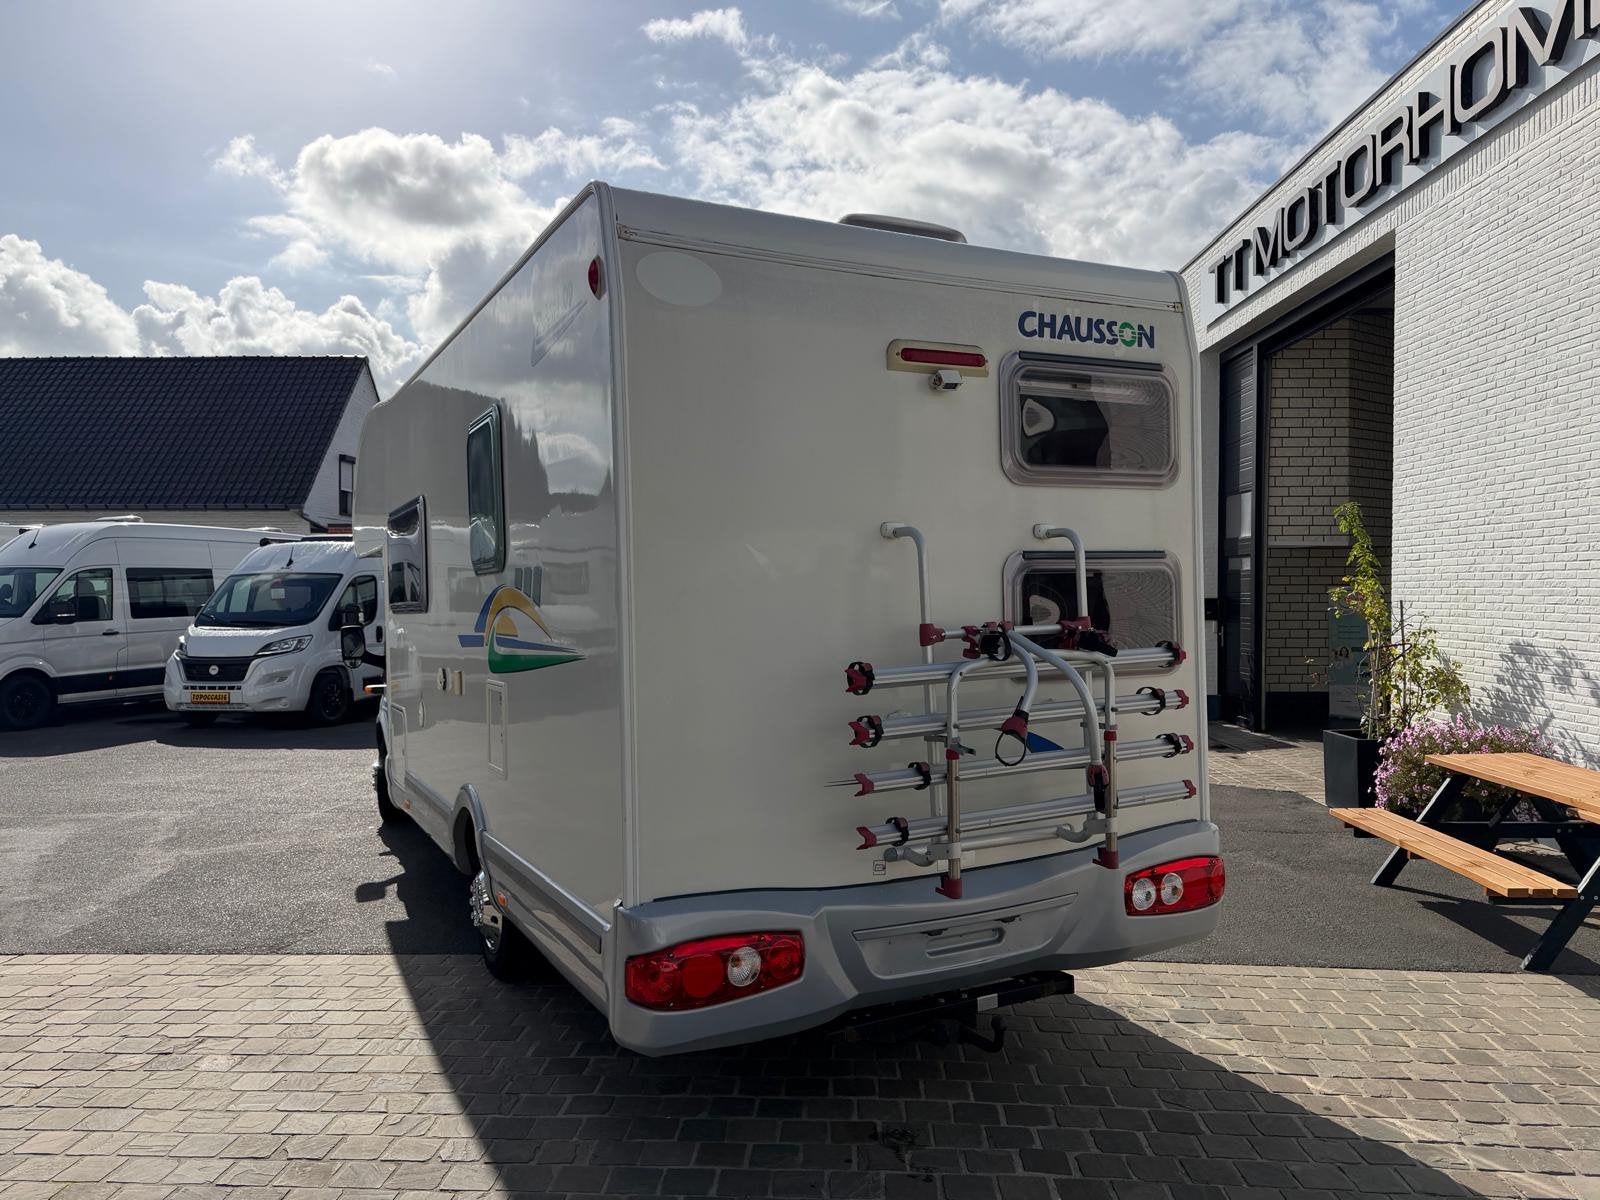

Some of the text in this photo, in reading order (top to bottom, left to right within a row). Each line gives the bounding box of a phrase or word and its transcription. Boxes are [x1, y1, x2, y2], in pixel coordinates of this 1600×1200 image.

[1253, 0, 1600, 276] MOTORHOM
[1018, 311, 1155, 348] CHAUSSON
[192, 693, 228, 701] TOPOCCASIE
